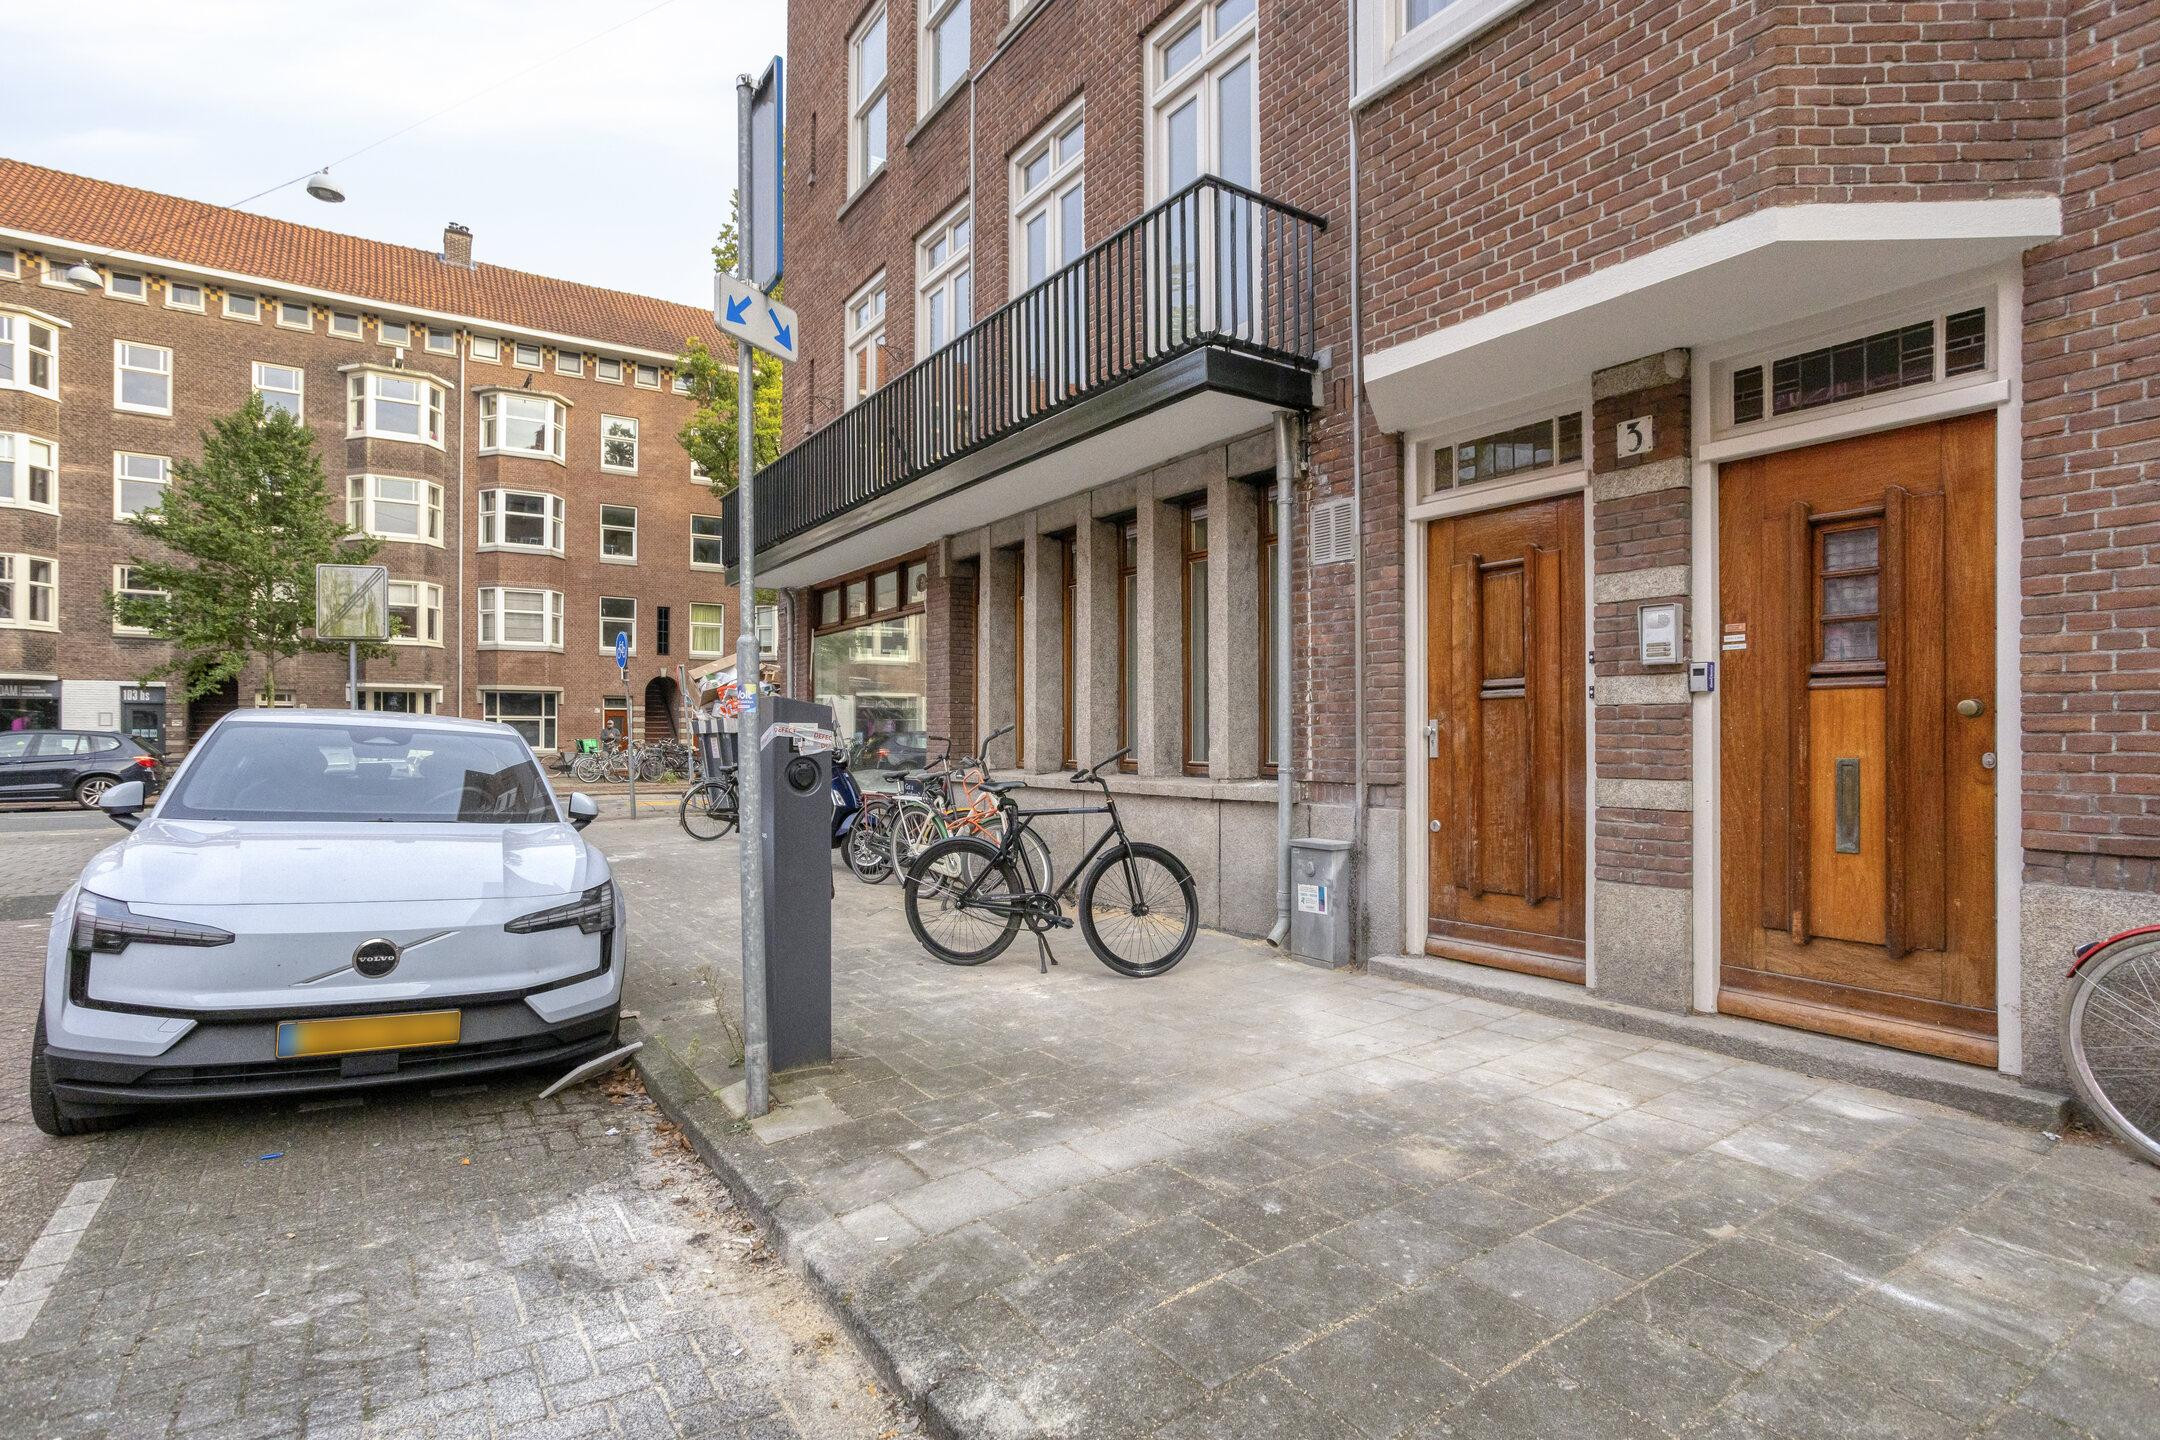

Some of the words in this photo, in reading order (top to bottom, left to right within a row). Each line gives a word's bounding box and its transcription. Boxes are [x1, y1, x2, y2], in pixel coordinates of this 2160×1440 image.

[1626, 421, 1644, 453] 3
[123, 689, 138, 701] 103
[357, 955, 395, 963] VOLVO
